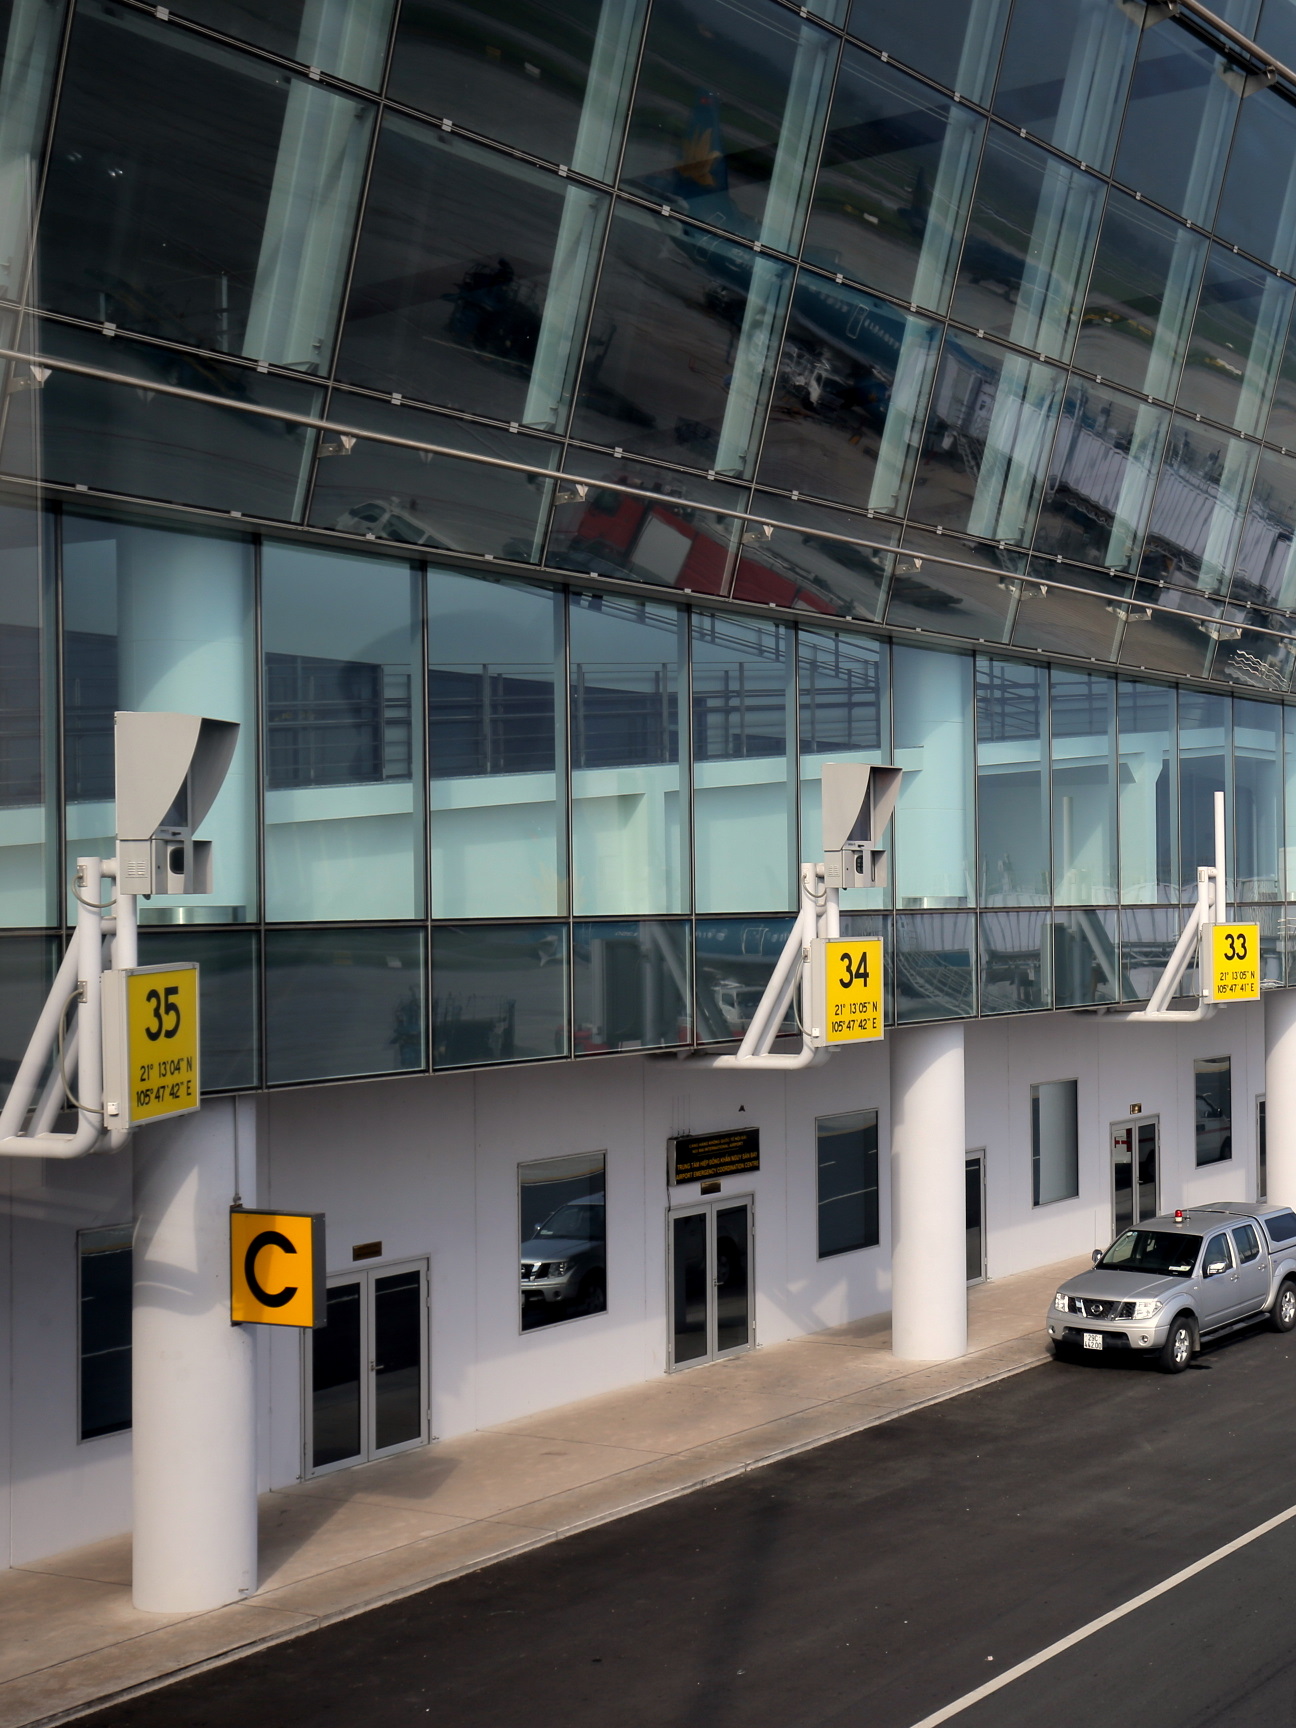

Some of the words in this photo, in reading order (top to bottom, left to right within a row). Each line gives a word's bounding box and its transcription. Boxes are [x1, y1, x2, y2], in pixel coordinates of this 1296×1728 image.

[1224, 933, 1247, 961] 33
[839, 952, 869, 988] 34
[1251, 971, 1255, 979] N
[1251, 983, 1255, 991] E
[145, 986, 181, 1041] 35
[872, 1001, 878, 1012] N
[872, 1018, 877, 1029] E
[186, 1056, 192, 1072] N
[186, 1080, 192, 1096] E
[676, 1172, 693, 1180] AIRPORT
[693, 1168, 717, 1177] EMERGENCY
[717, 1163, 745, 1173] COORDINATION
[745, 1160, 759, 1169] CENTRE
[244, 1231, 298, 1308] C
